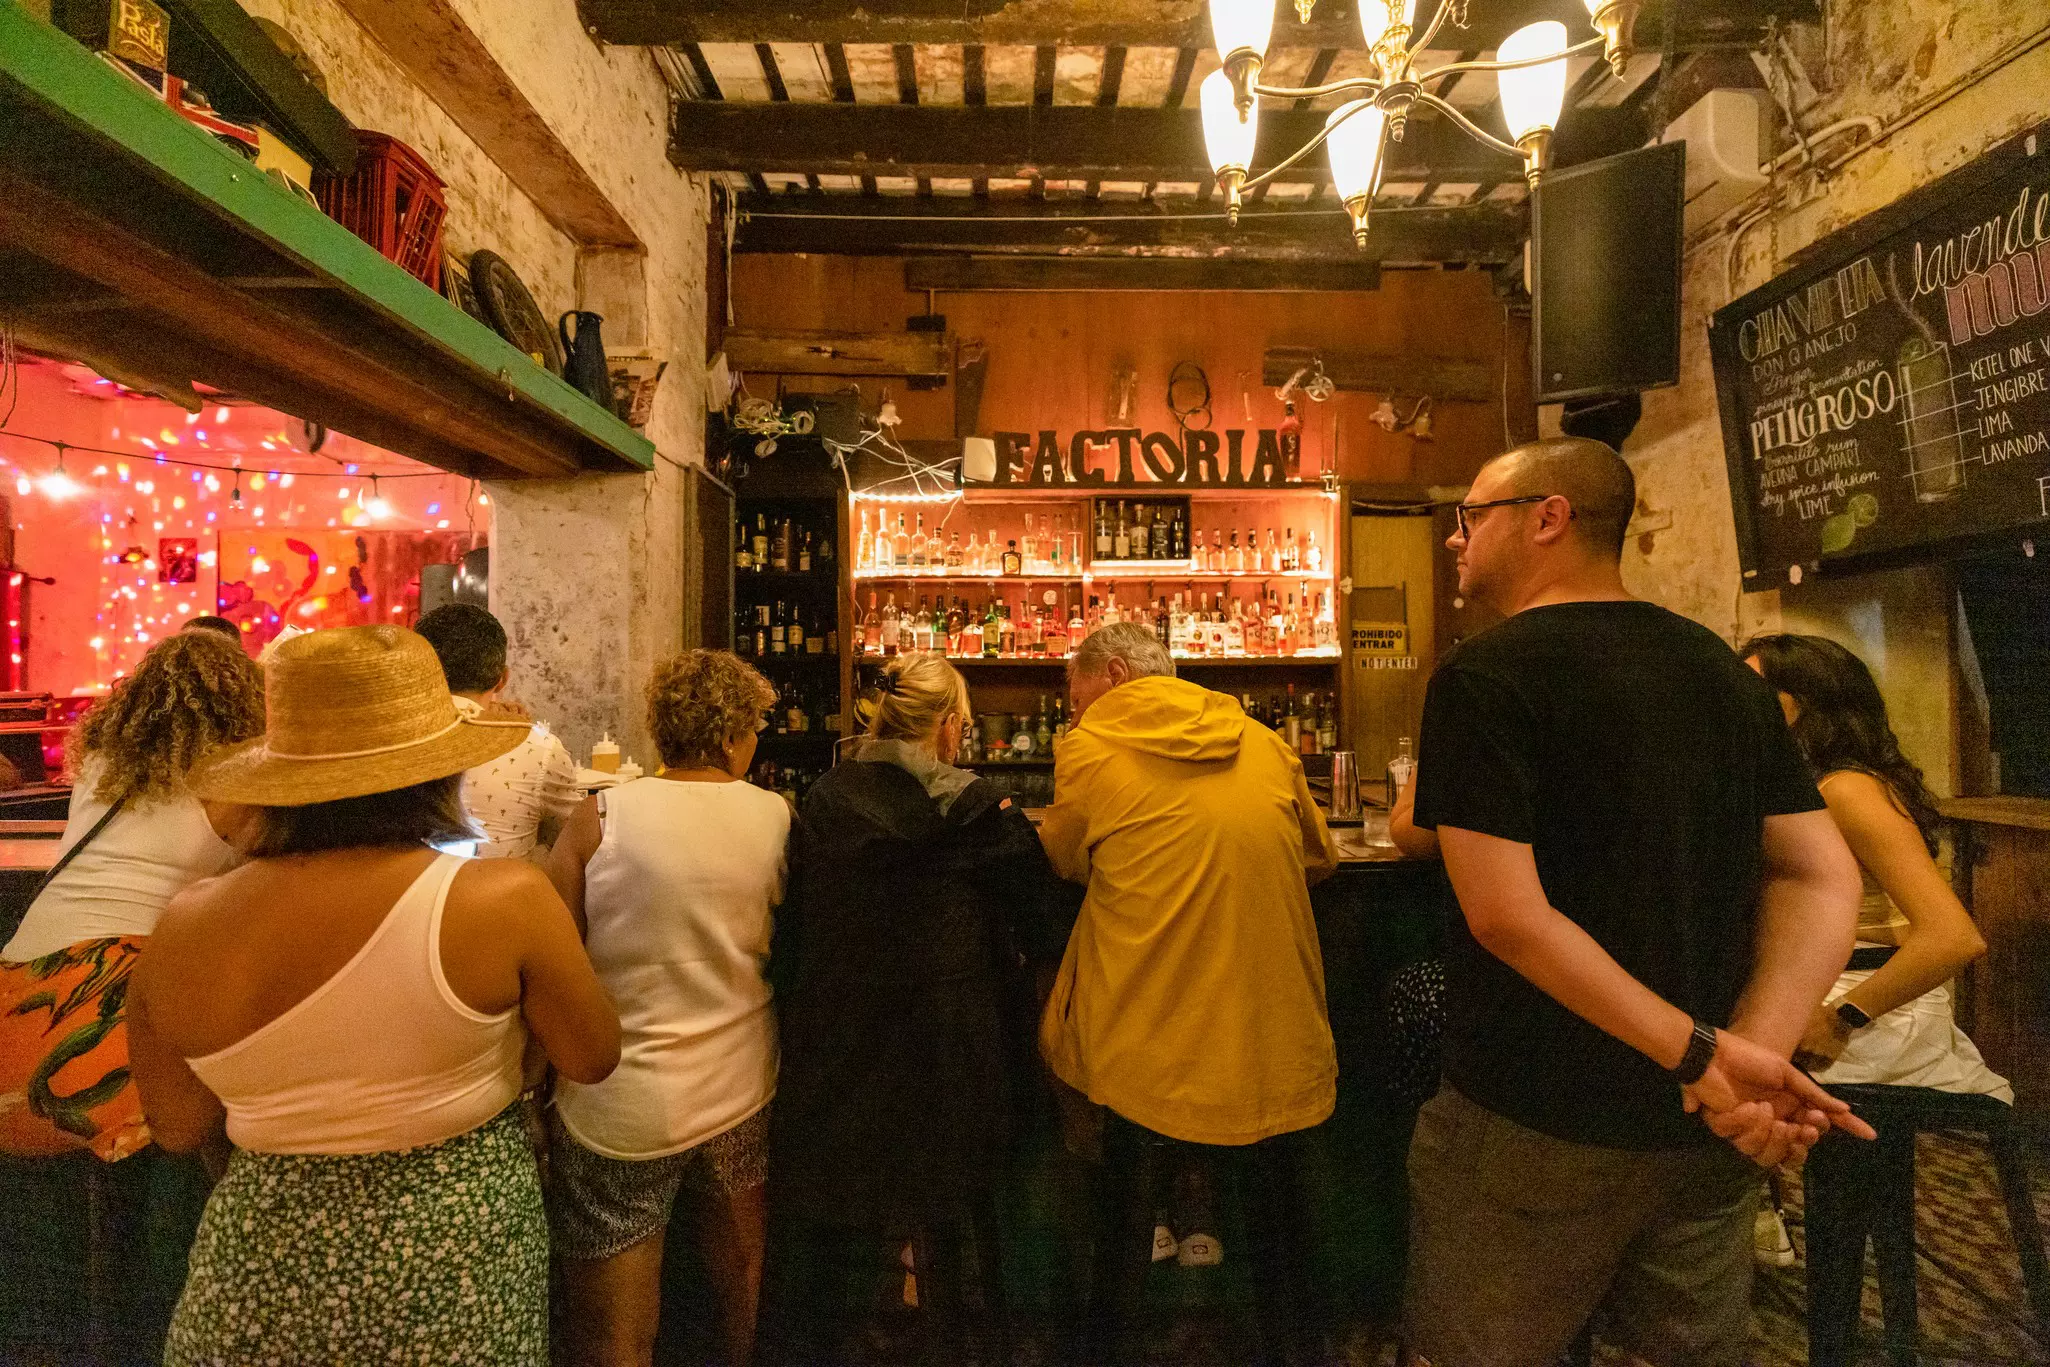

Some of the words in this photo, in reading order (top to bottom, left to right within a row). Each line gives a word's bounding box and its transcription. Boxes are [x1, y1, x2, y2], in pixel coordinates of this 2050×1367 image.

[1911, 186, 2050, 301] lavende
[1944, 238, 2050, 347] mu
[1753, 354, 1784, 384] DON
[1788, 347, 1801, 367] Q
[1970, 352, 2007, 382] KETEL
[2009, 341, 2036, 368] ONE
[1974, 368, 2049, 411] JENGIBRE
[1750, 370, 1895, 460] PELIGROSO
[1978, 410, 2014, 439] LIMA
[995, 428, 1288, 484] FACTORIA
[1805, 447, 1861, 478] CAMPARI
[1825, 438, 1860, 454] rum
[1981, 430, 2050, 466] LAVANDA
[1821, 470, 1881, 498] infusion
[1800, 494, 1834, 520] LIME
[1352, 629, 1403, 639] ROHIBIDO
[1353, 640, 1395, 649] ENTRAR
[1361, 657, 1382, 669] NOT
[1385, 657, 1417, 669] ENTER
